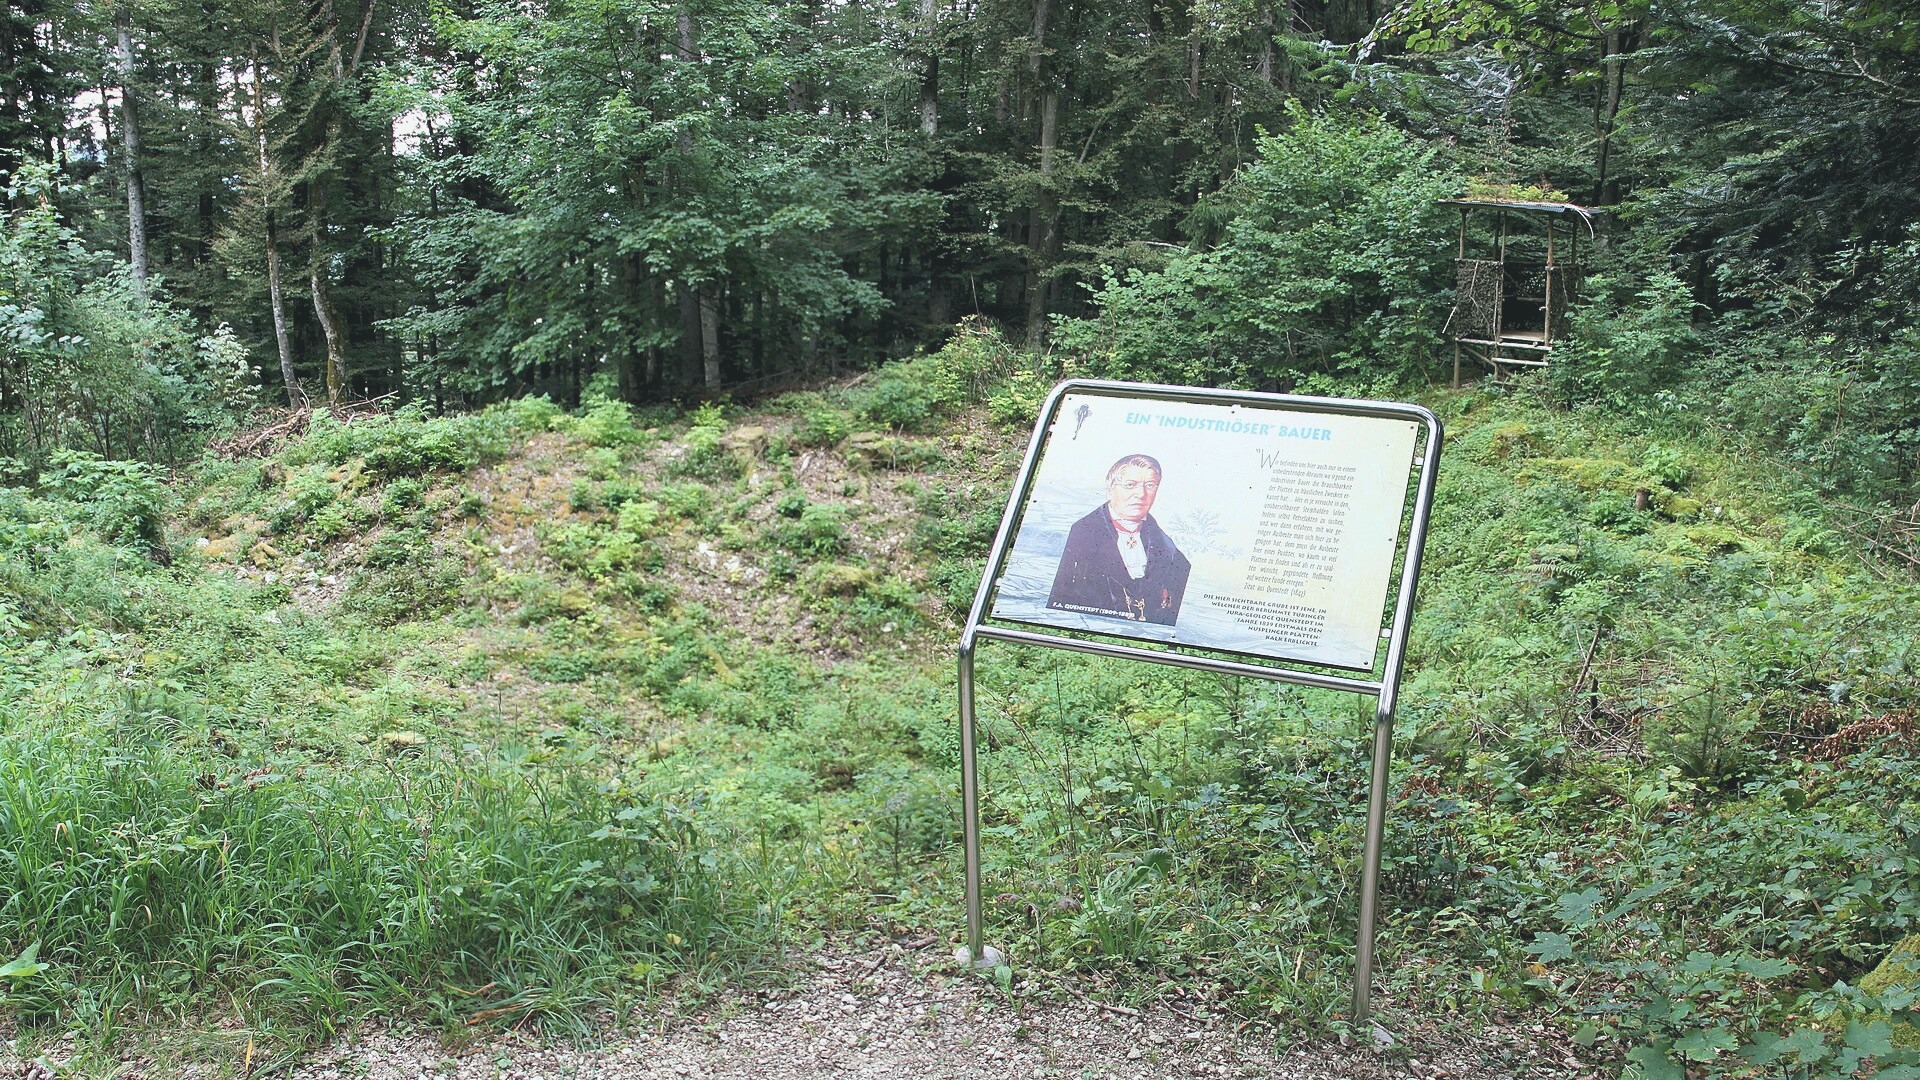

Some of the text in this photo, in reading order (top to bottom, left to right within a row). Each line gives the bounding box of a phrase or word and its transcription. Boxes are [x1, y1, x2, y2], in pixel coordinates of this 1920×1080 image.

[1126, 412, 1151, 424] EIN
[1278, 425, 1332, 441] BAUER
[1280, 460, 1298, 468] befinden
[1321, 481, 1353, 490] Brauchbarkeit
[1272, 530, 1292, 539] Ausbeute
[1253, 546, 1262, 554] hier
[1319, 545, 1339, 553] Ausbeute
[1211, 602, 1241, 610] WELCHER
[1232, 598, 1266, 606] SICHTBARE
[1064, 604, 1099, 613] QUENSTEDT
[1227, 610, 1274, 620] JURA-GEOLOGE
[1276, 616, 1314, 625] QUENSTEDT
[1248, 626, 1289, 636] NUSPLINGER
[1275, 623, 1307, 631] ERSTMALS
